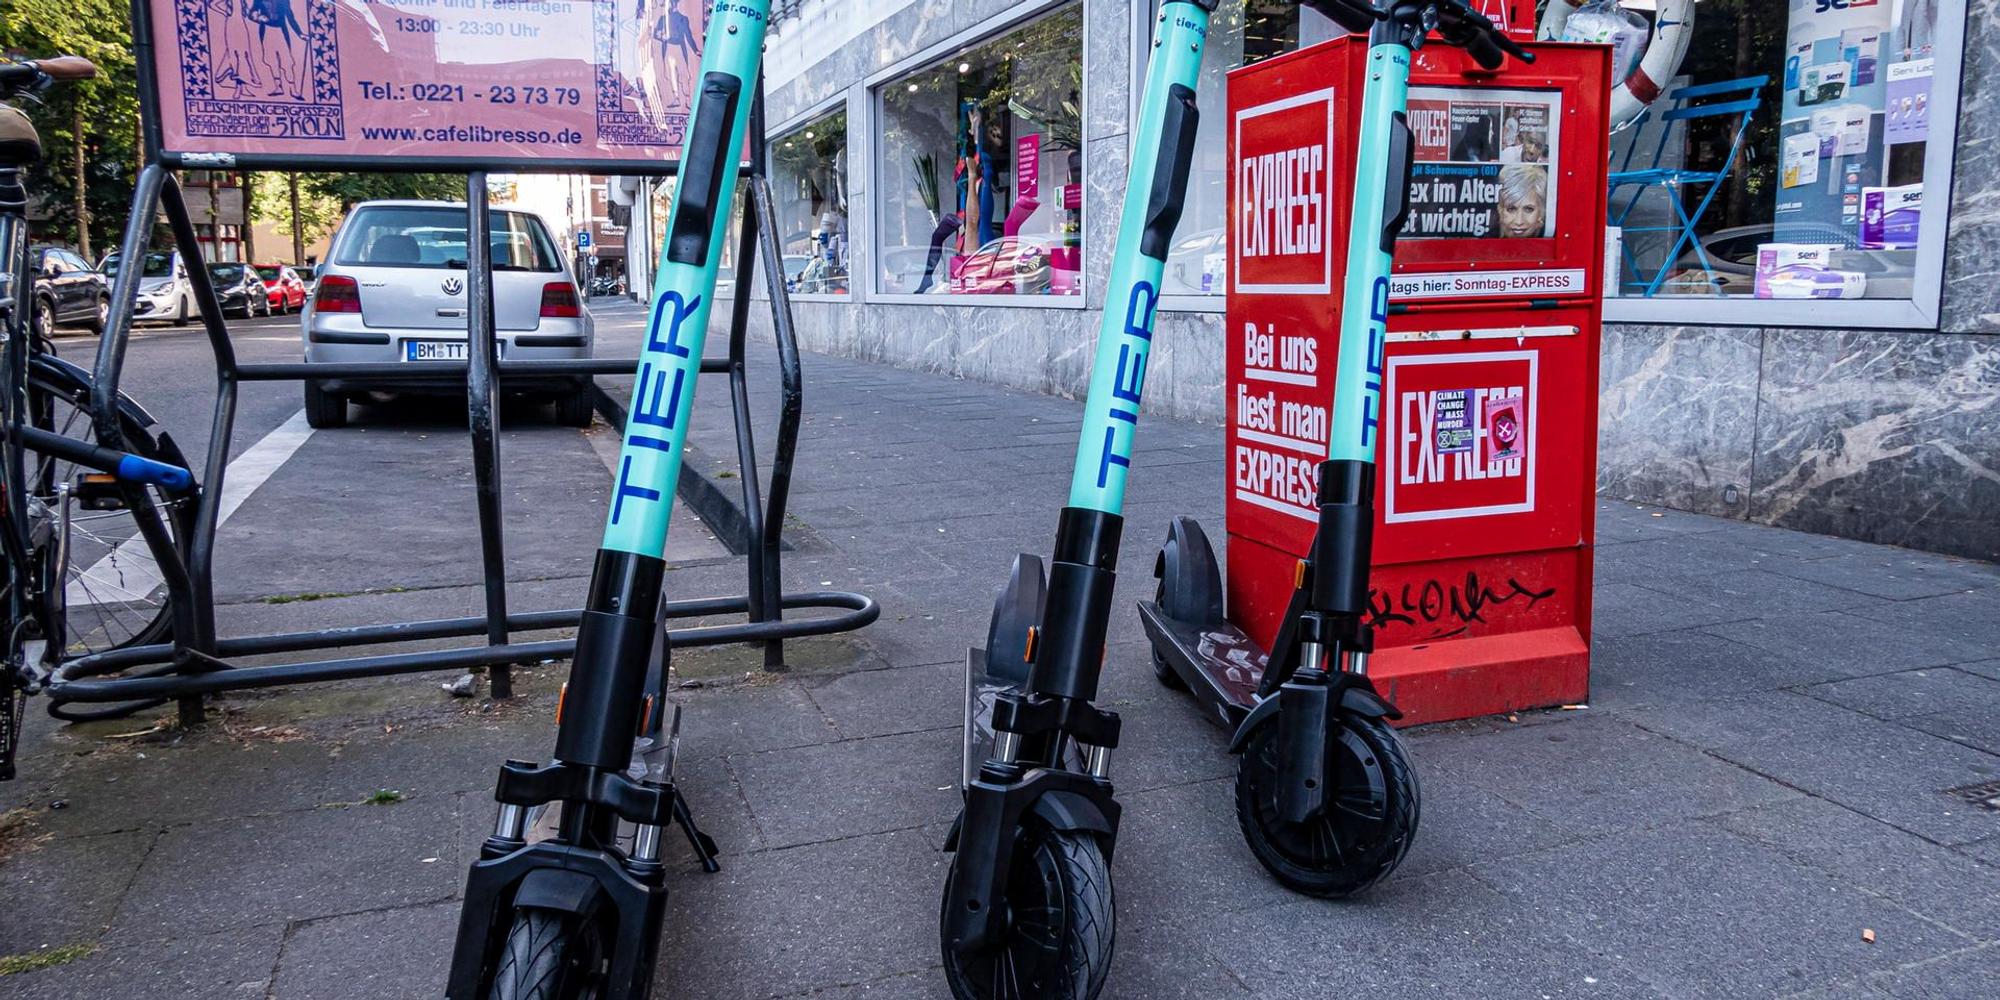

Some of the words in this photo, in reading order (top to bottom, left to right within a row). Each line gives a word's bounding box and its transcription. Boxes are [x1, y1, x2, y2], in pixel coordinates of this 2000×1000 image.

[396, 18, 440, 32] 13:00
[460, 21, 504, 36] 23:30
[510, 23, 540, 37] Uhr
[358, 81, 404, 100] Tel.:
[412, 84, 463, 102] 0221
[490, 85, 516, 104] 23
[523, 87, 548, 104] 73
[555, 88, 580, 105] 79
[361, 125, 582, 144] www.cafelibresso.de
[1410, 183, 1429, 203] ex
[1433, 178, 1456, 203] im
[1459, 178, 1503, 203] Alter
[1243, 144, 1323, 257] EXPRESS
[1421, 207, 1491, 236] wichtig!
[1797, 250, 1819, 260] seni
[1389, 280, 1419, 294] tags
[1423, 279, 1451, 292] hier:
[1455, 275, 1570, 291] Sonntag-EXPRESS
[418, 344, 436, 358] BM
[446, 344, 463, 358] TT
[1245, 322, 1274, 368] Bei
[1281, 335, 1317, 373] uns
[1096, 280, 1160, 488] TIER
[1437, 391, 1465, 400] CLIMATE
[612, 290, 701, 524] TIER
[1237, 383, 1276, 432] liest
[1282, 401, 1327, 442] man
[1437, 401, 1464, 410] CHANGE
[1445, 410, 1464, 419] MASS
[1437, 420, 1463, 429] MURDER
